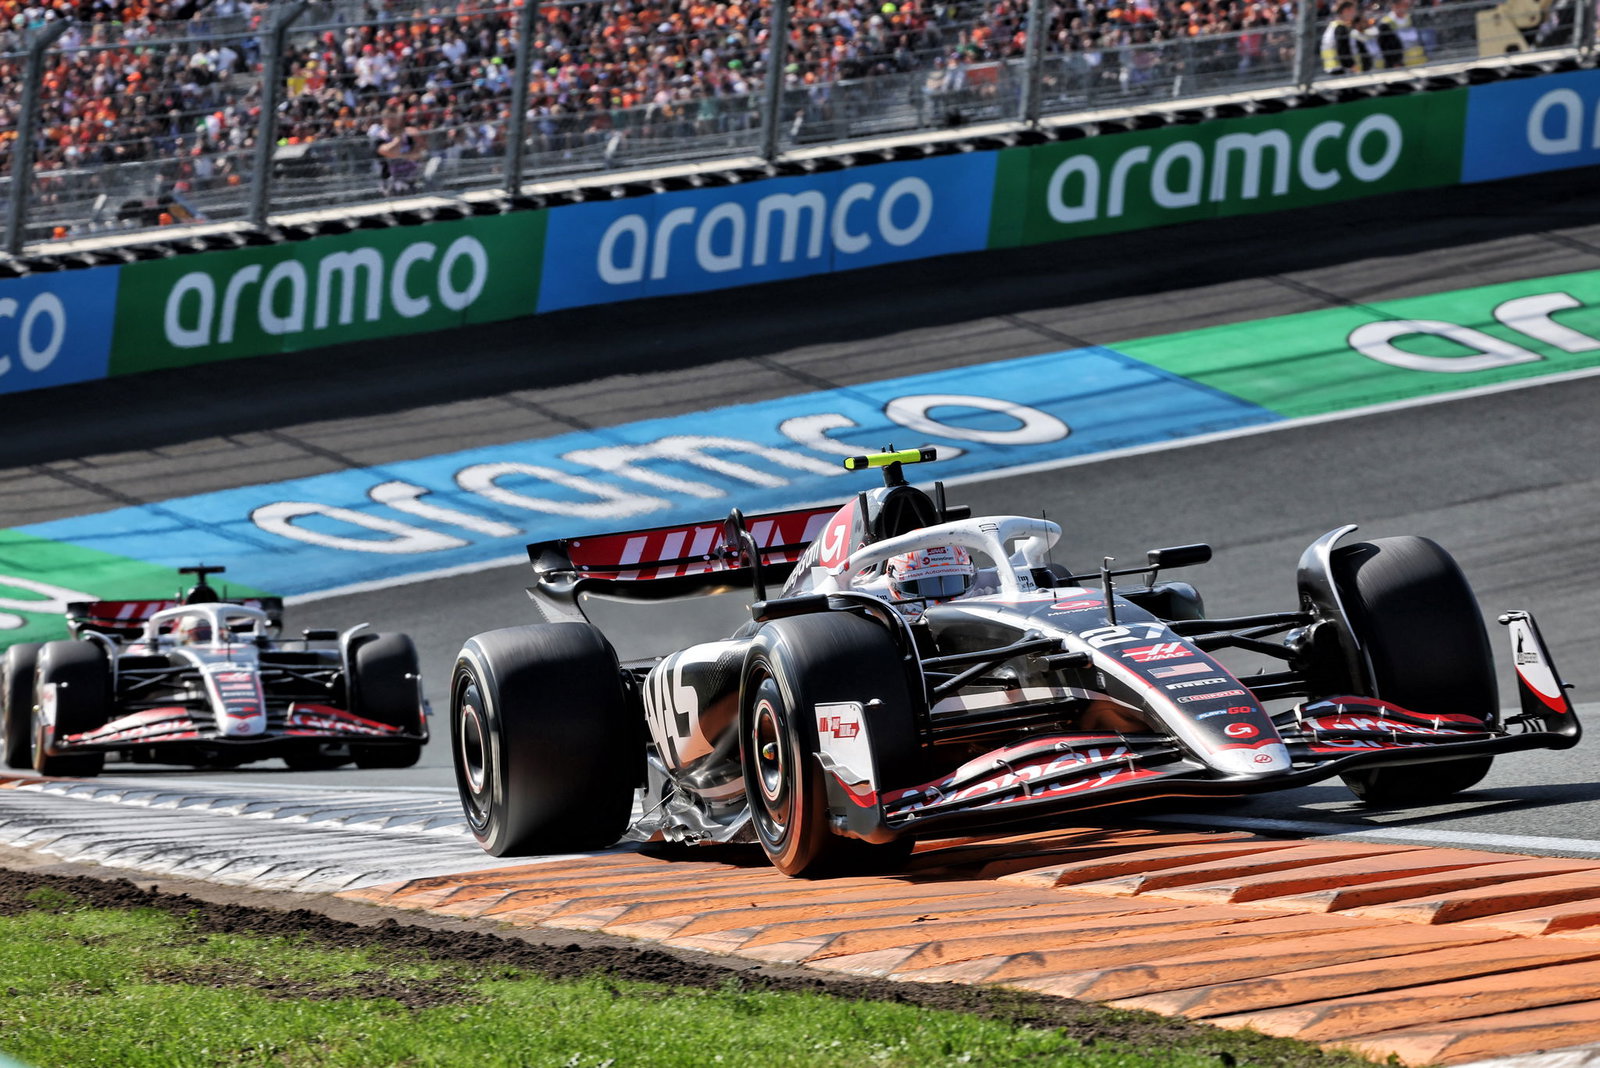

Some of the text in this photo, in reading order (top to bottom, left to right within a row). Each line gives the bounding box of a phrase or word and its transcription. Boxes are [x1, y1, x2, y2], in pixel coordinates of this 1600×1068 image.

[1046, 113, 1402, 223] aramco
[597, 176, 933, 285] aramco
[164, 235, 488, 348] aramco
[250, 394, 1070, 554] aramco
[925, 568, 960, 576] Automation
[1080, 622, 1168, 649] 27
